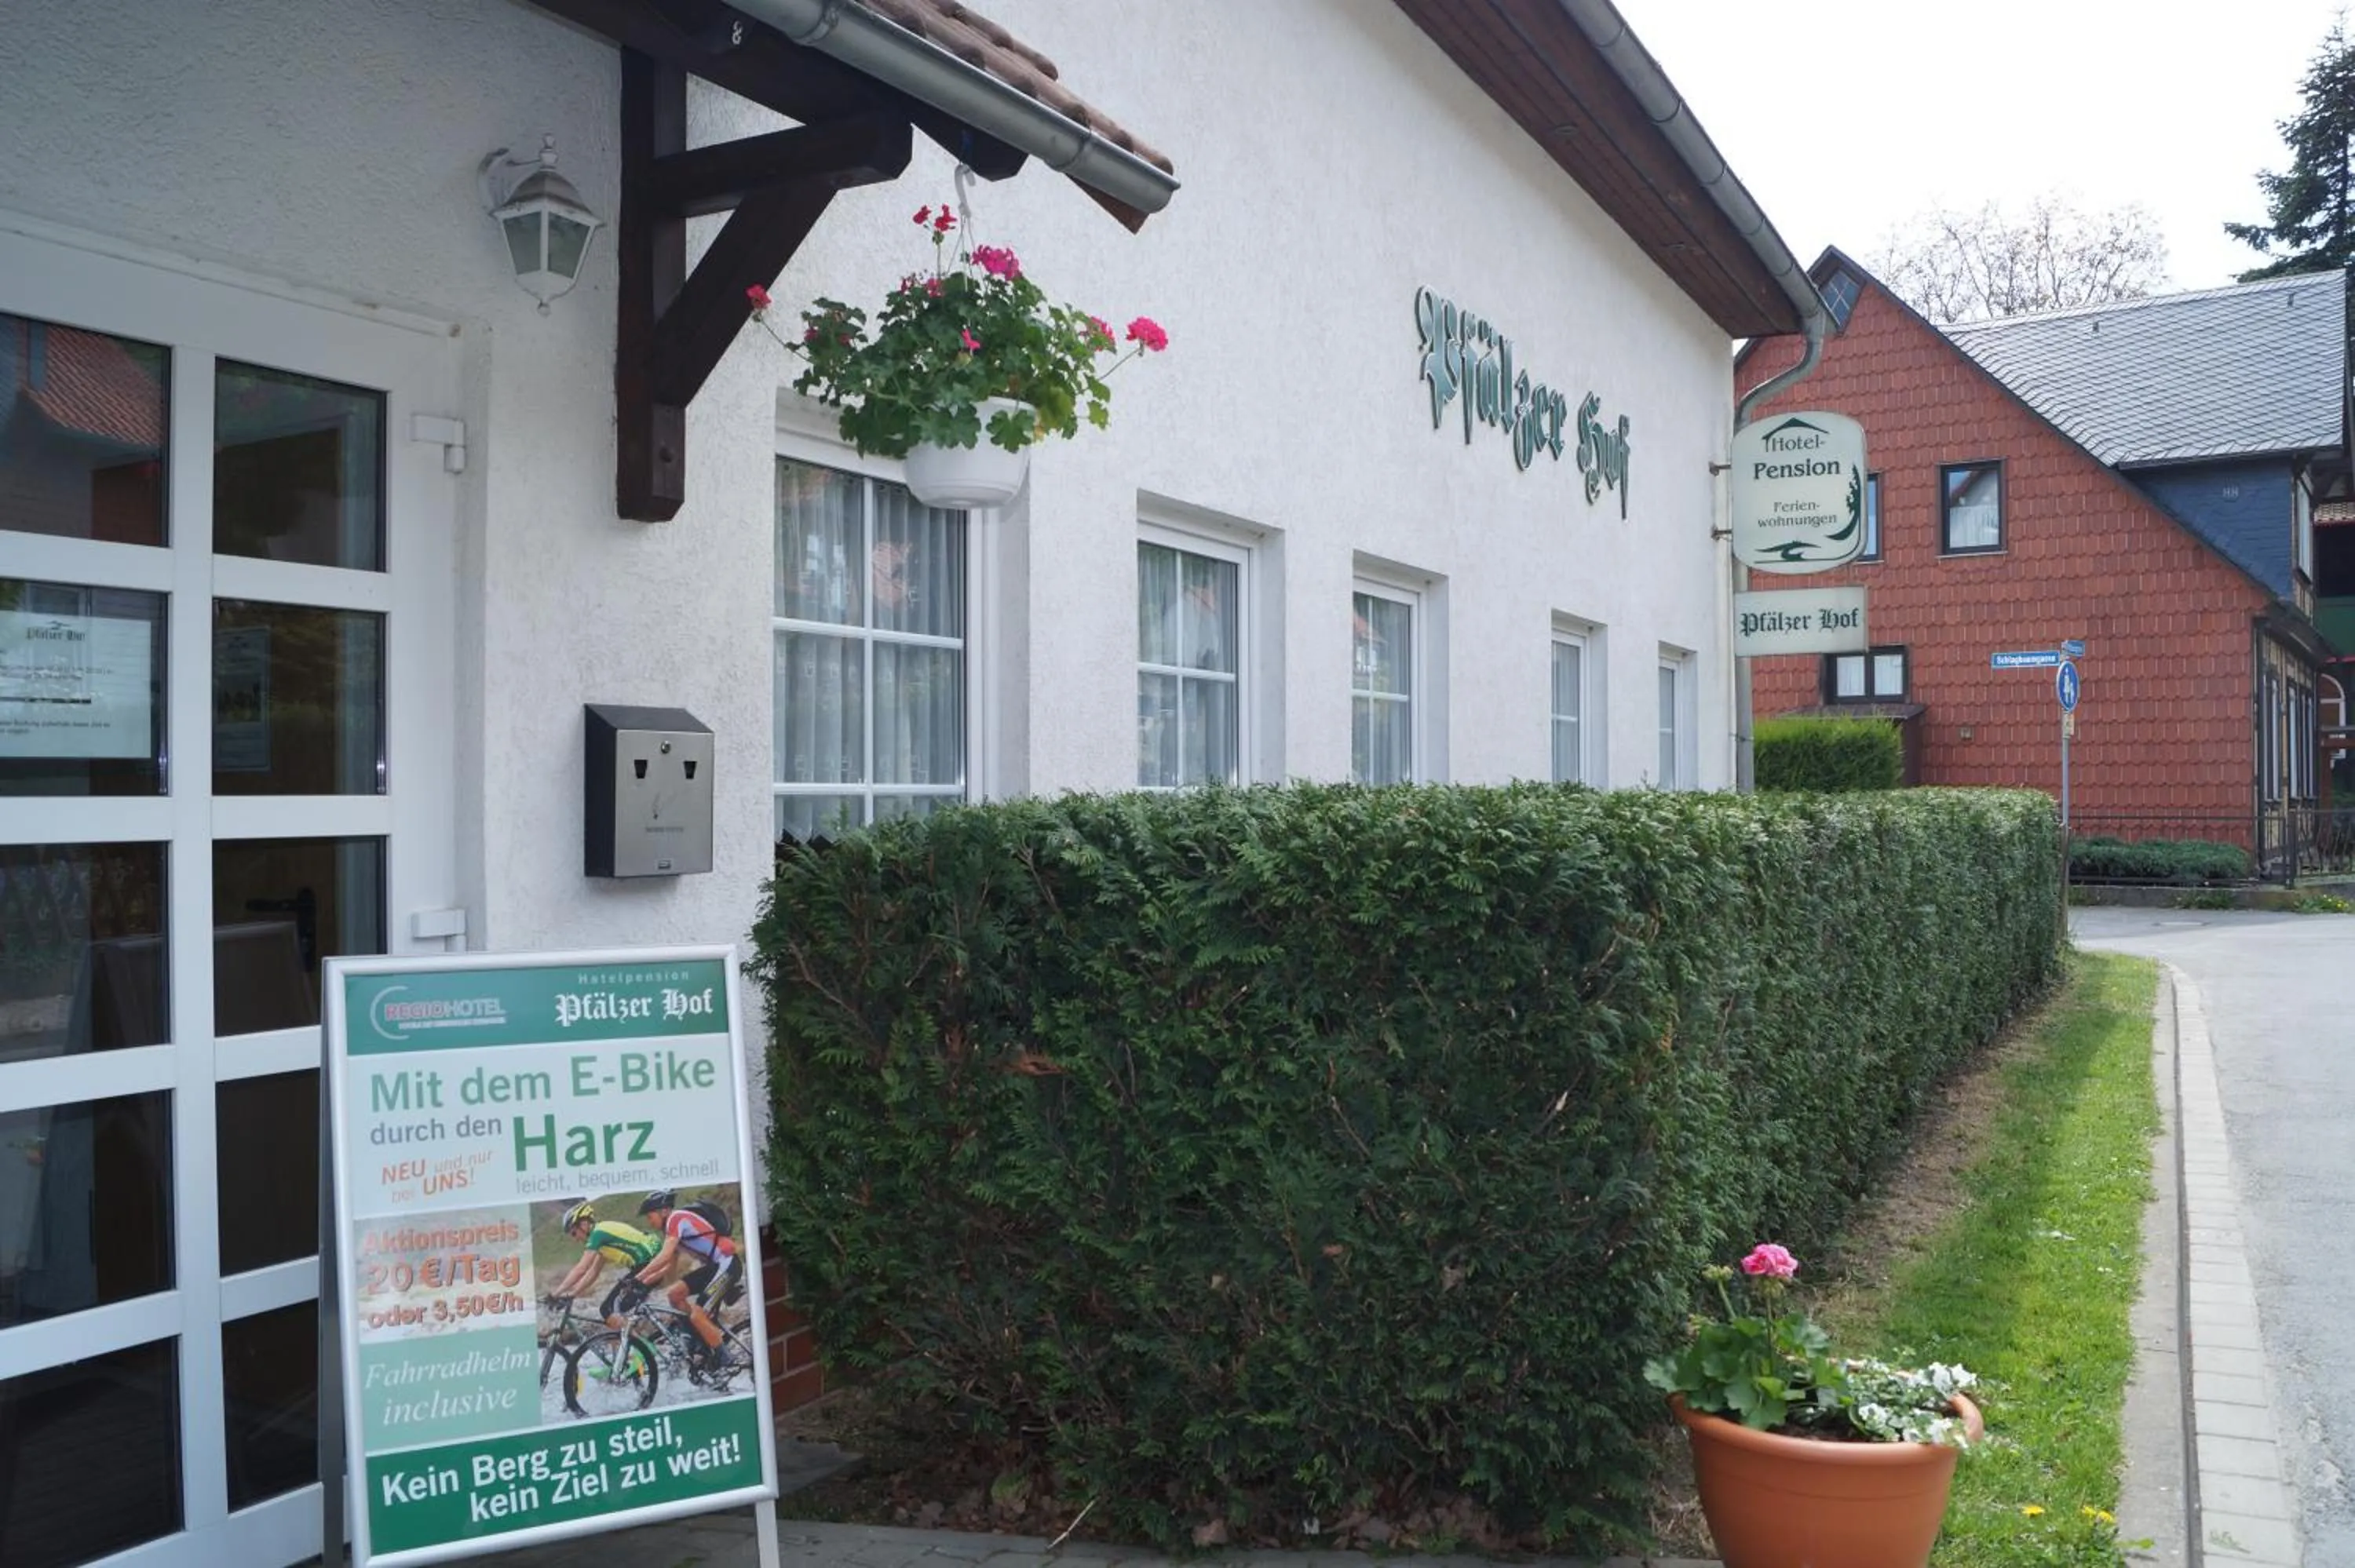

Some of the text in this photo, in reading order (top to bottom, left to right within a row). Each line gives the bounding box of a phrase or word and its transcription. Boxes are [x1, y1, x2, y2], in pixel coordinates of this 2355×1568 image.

[732, 20, 743, 45] 8
[1772, 434, 1826, 452] Hotel-
[1754, 458, 1841, 480] Pension
[1758, 514, 1838, 527] wohnungen
[1773, 500, 1820, 512] Ferien-
[1739, 607, 1859, 637] Pfälzer Hof
[578, 970, 689, 985] Hotelpension
[554, 988, 714, 1026] Pfälzer Hof
[371, 1051, 715, 1113] Mit dem E-Bike
[371, 1114, 656, 1172] durch den Harz
[382, 1158, 425, 1185] NEU
[423, 1167, 476, 1195] UNS!
[516, 1159, 719, 1194] leicht, bequem, schnell
[363, 1219, 518, 1255] Aktionspreis
[368, 1304, 427, 1329] oder
[365, 1347, 531, 1388] Fahrradhelm
[383, 1385, 517, 1426] inclusive
[382, 1416, 682, 1506] Kein Berg zu steil,
[471, 1433, 741, 1522] kein Ziel zu weit!
